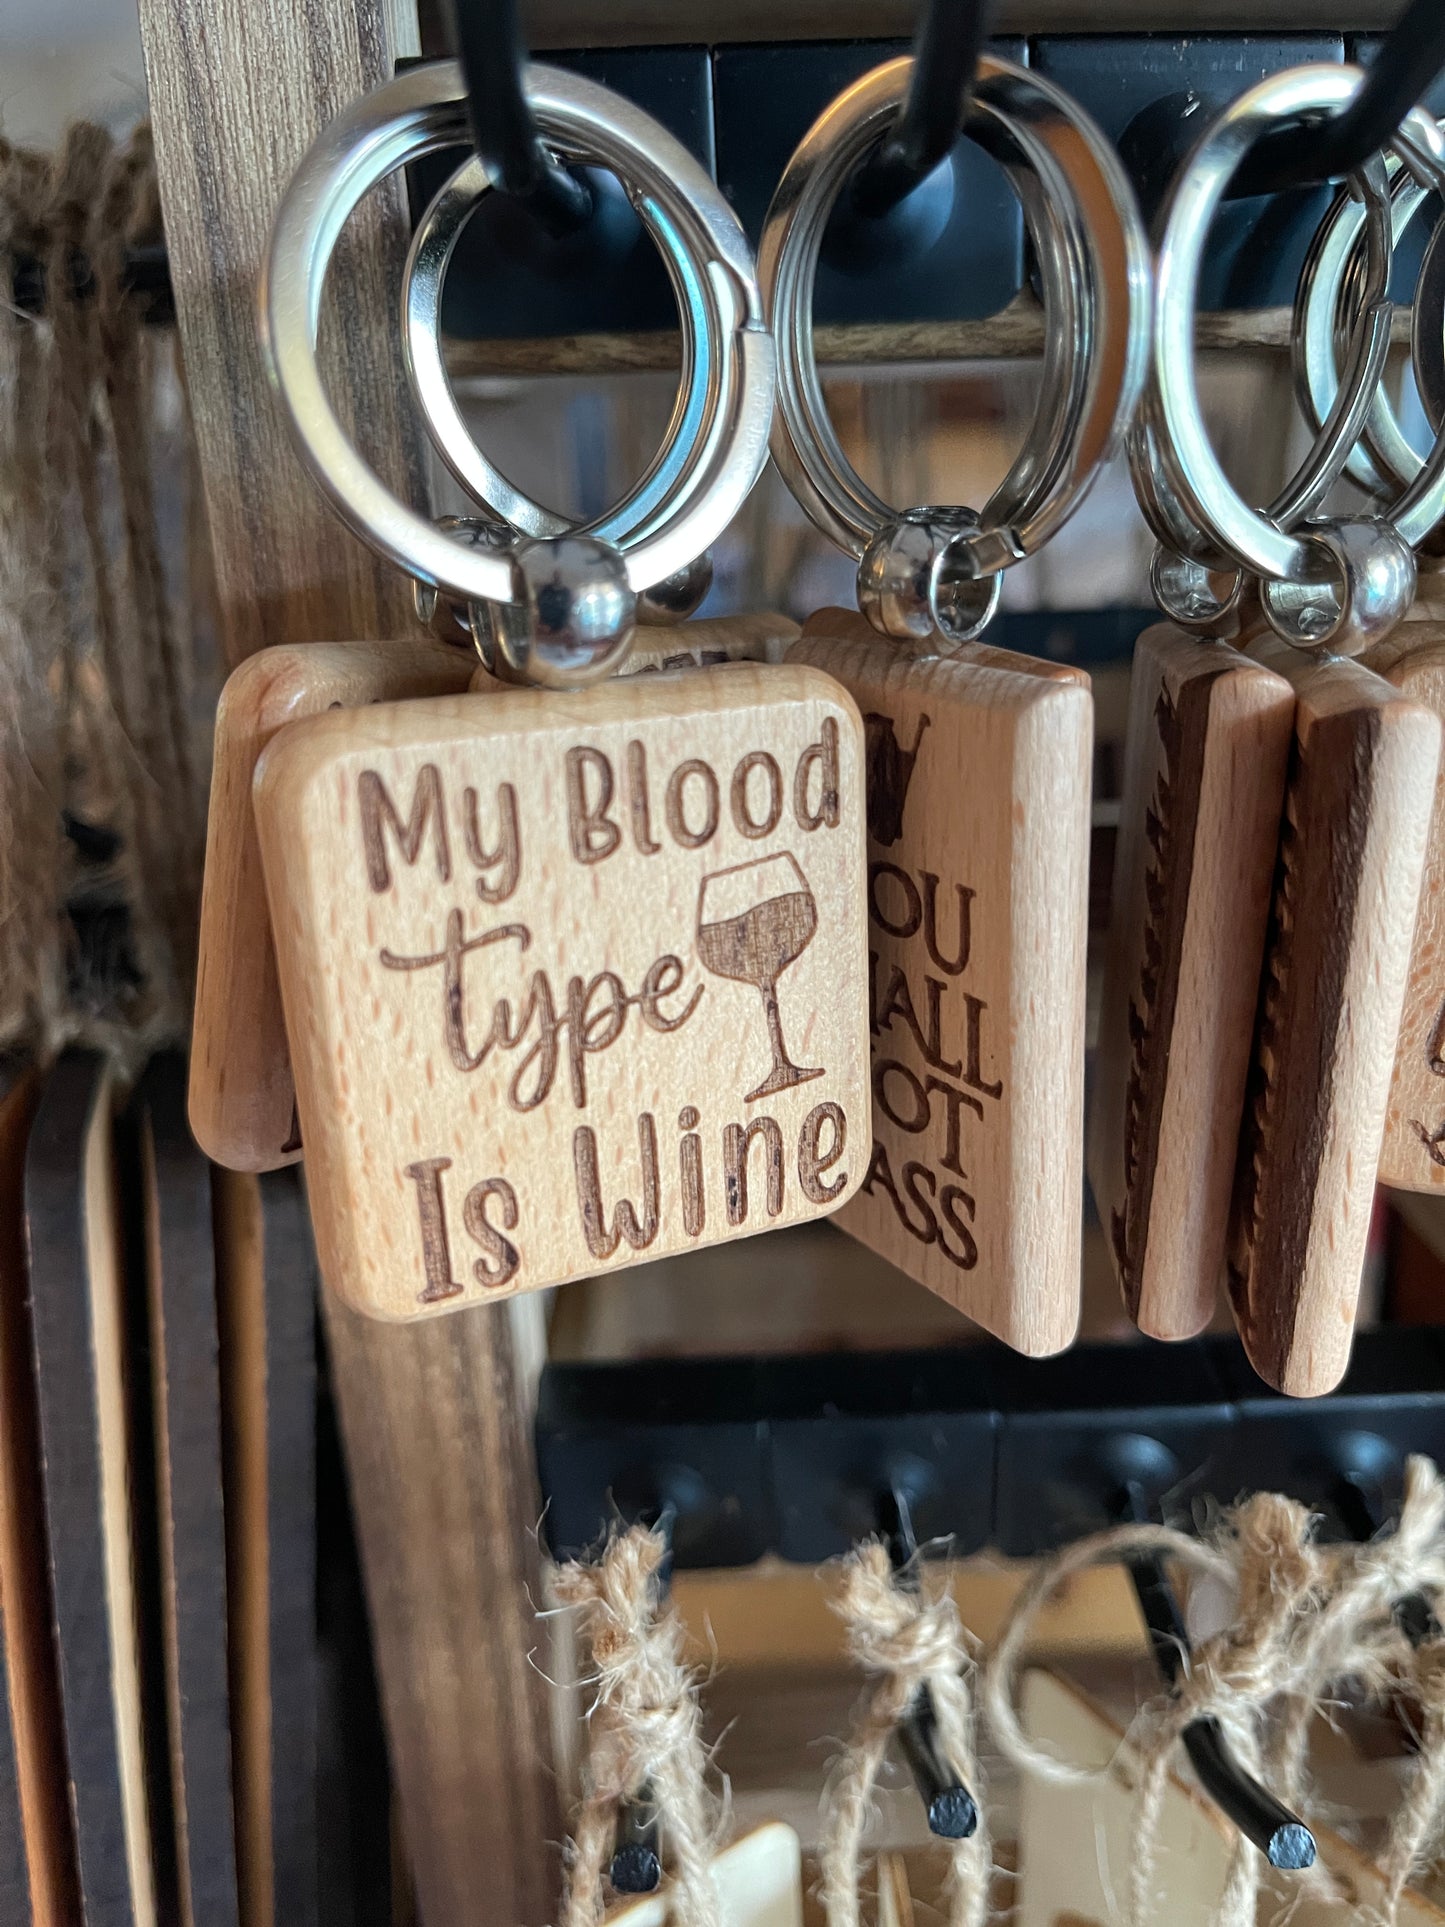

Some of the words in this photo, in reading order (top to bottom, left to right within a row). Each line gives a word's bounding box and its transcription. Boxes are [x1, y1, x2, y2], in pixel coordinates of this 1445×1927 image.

[357, 763, 524, 904] My
[564, 716, 842, 866] Blood
[868, 860, 977, 976] OU
[379, 908, 705, 1112] type
[870, 951, 1003, 1100] ALL
[871, 1045, 984, 1179] OT
[403, 1157, 521, 1303] Is
[572, 1101, 848, 1260] Wine
[862, 1137, 978, 1271] ASS
